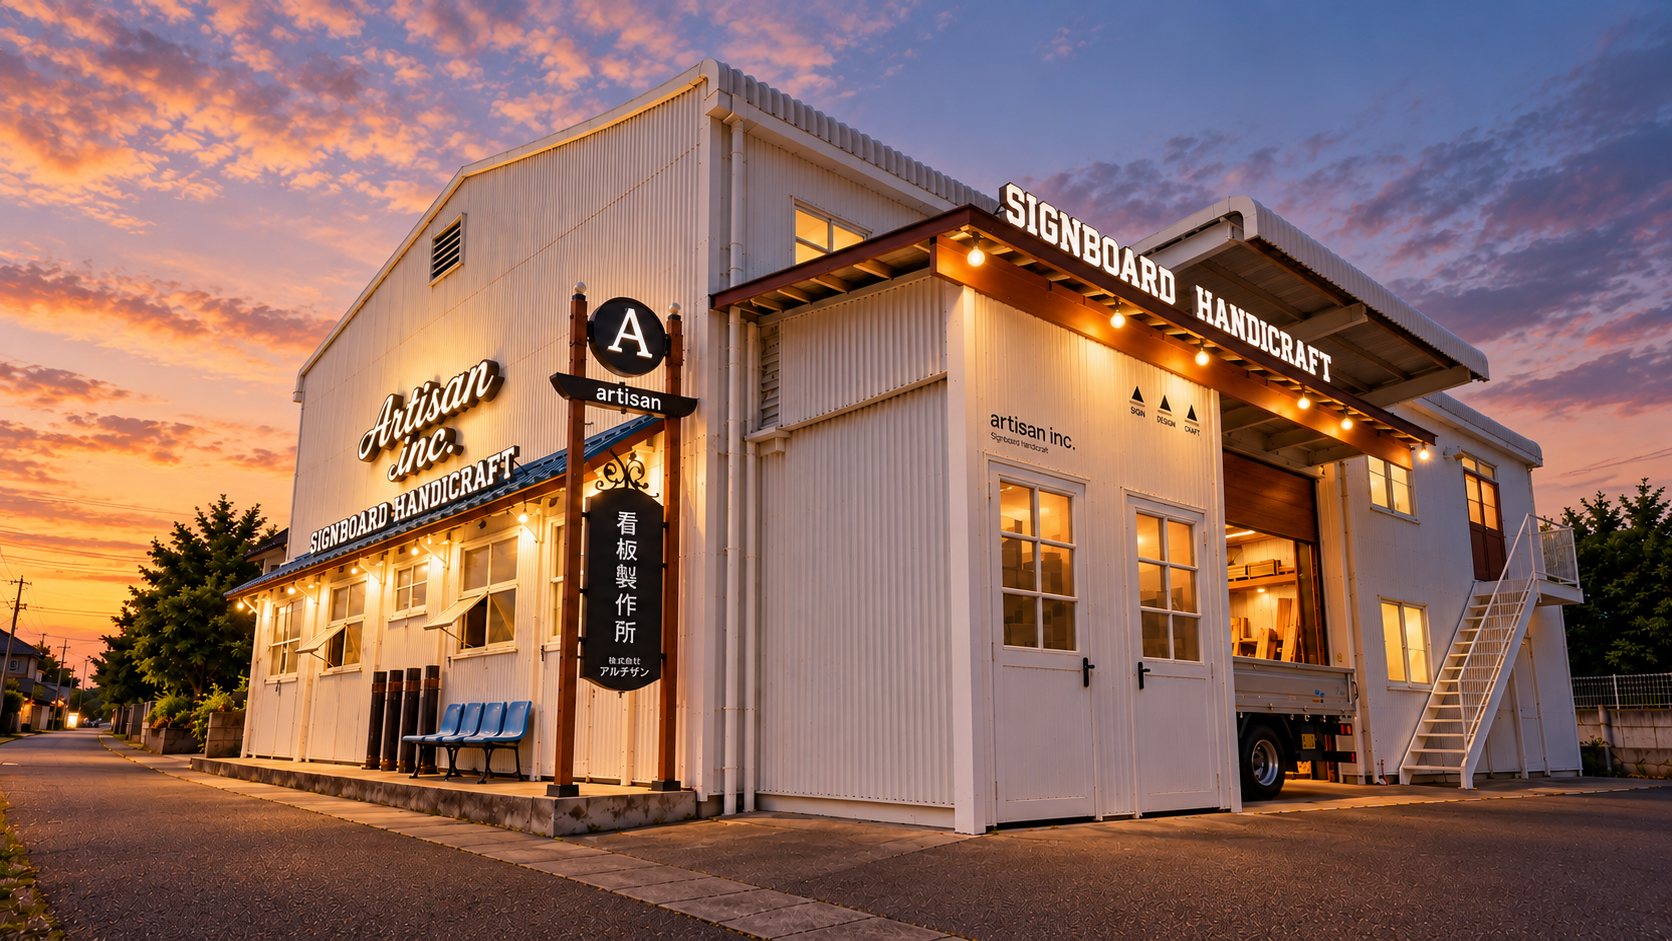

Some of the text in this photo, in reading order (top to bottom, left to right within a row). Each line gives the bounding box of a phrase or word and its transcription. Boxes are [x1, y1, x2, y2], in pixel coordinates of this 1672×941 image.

[1004, 182, 1332, 383] SIGNBOARD HANDICRAFT
[607, 307, 653, 359] A
[358, 359, 497, 461] Artisan
[596, 387, 661, 411] artisan
[388, 427, 455, 482] inc.
[990, 413, 1076, 451] artisan inc.
[309, 446, 518, 554] SIGNBOARD HANDICRAFT
[614, 511, 639, 644] 看板製作所
[600, 666, 650, 678] アルチザン
